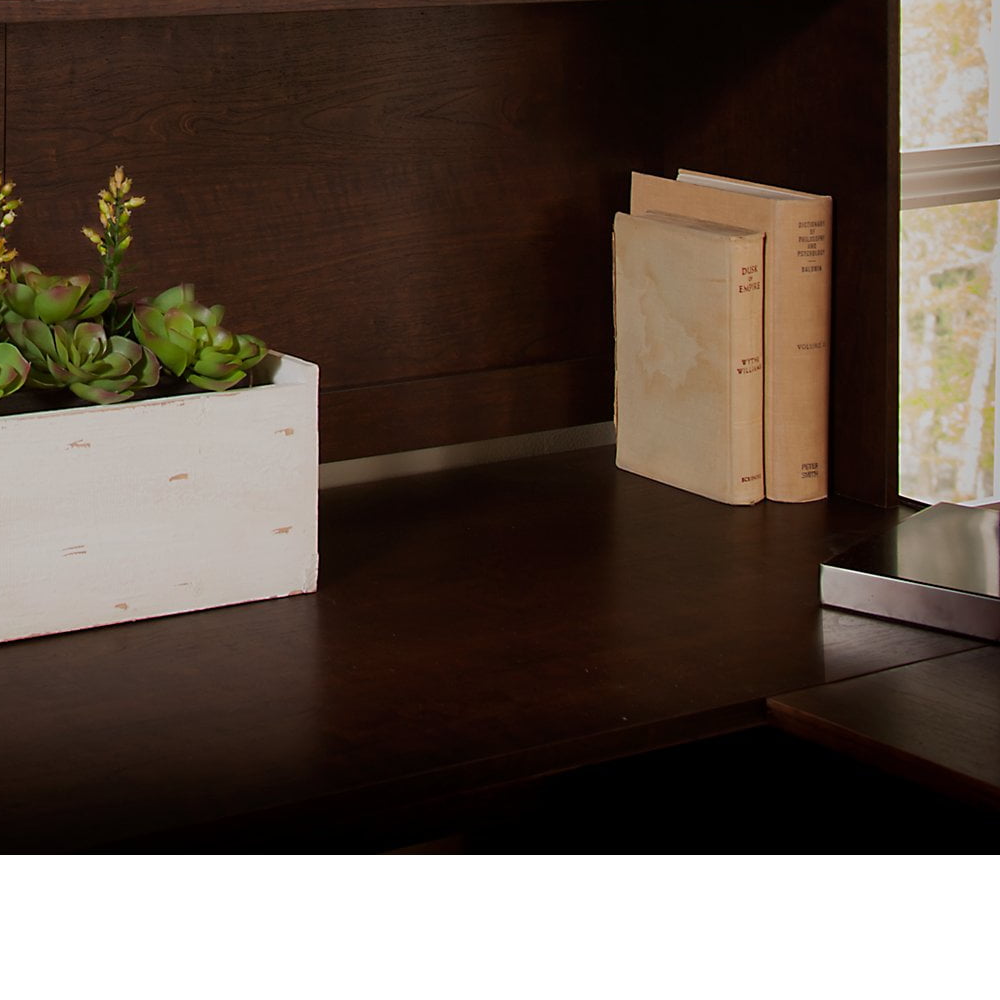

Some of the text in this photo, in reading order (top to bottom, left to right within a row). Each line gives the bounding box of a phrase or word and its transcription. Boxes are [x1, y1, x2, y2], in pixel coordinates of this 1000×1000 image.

[741, 265, 758, 276] DUSK
[738, 281, 761, 294] EMPIRE
[801, 462, 819, 470] PETER
[800, 470, 819, 479] SMITH
